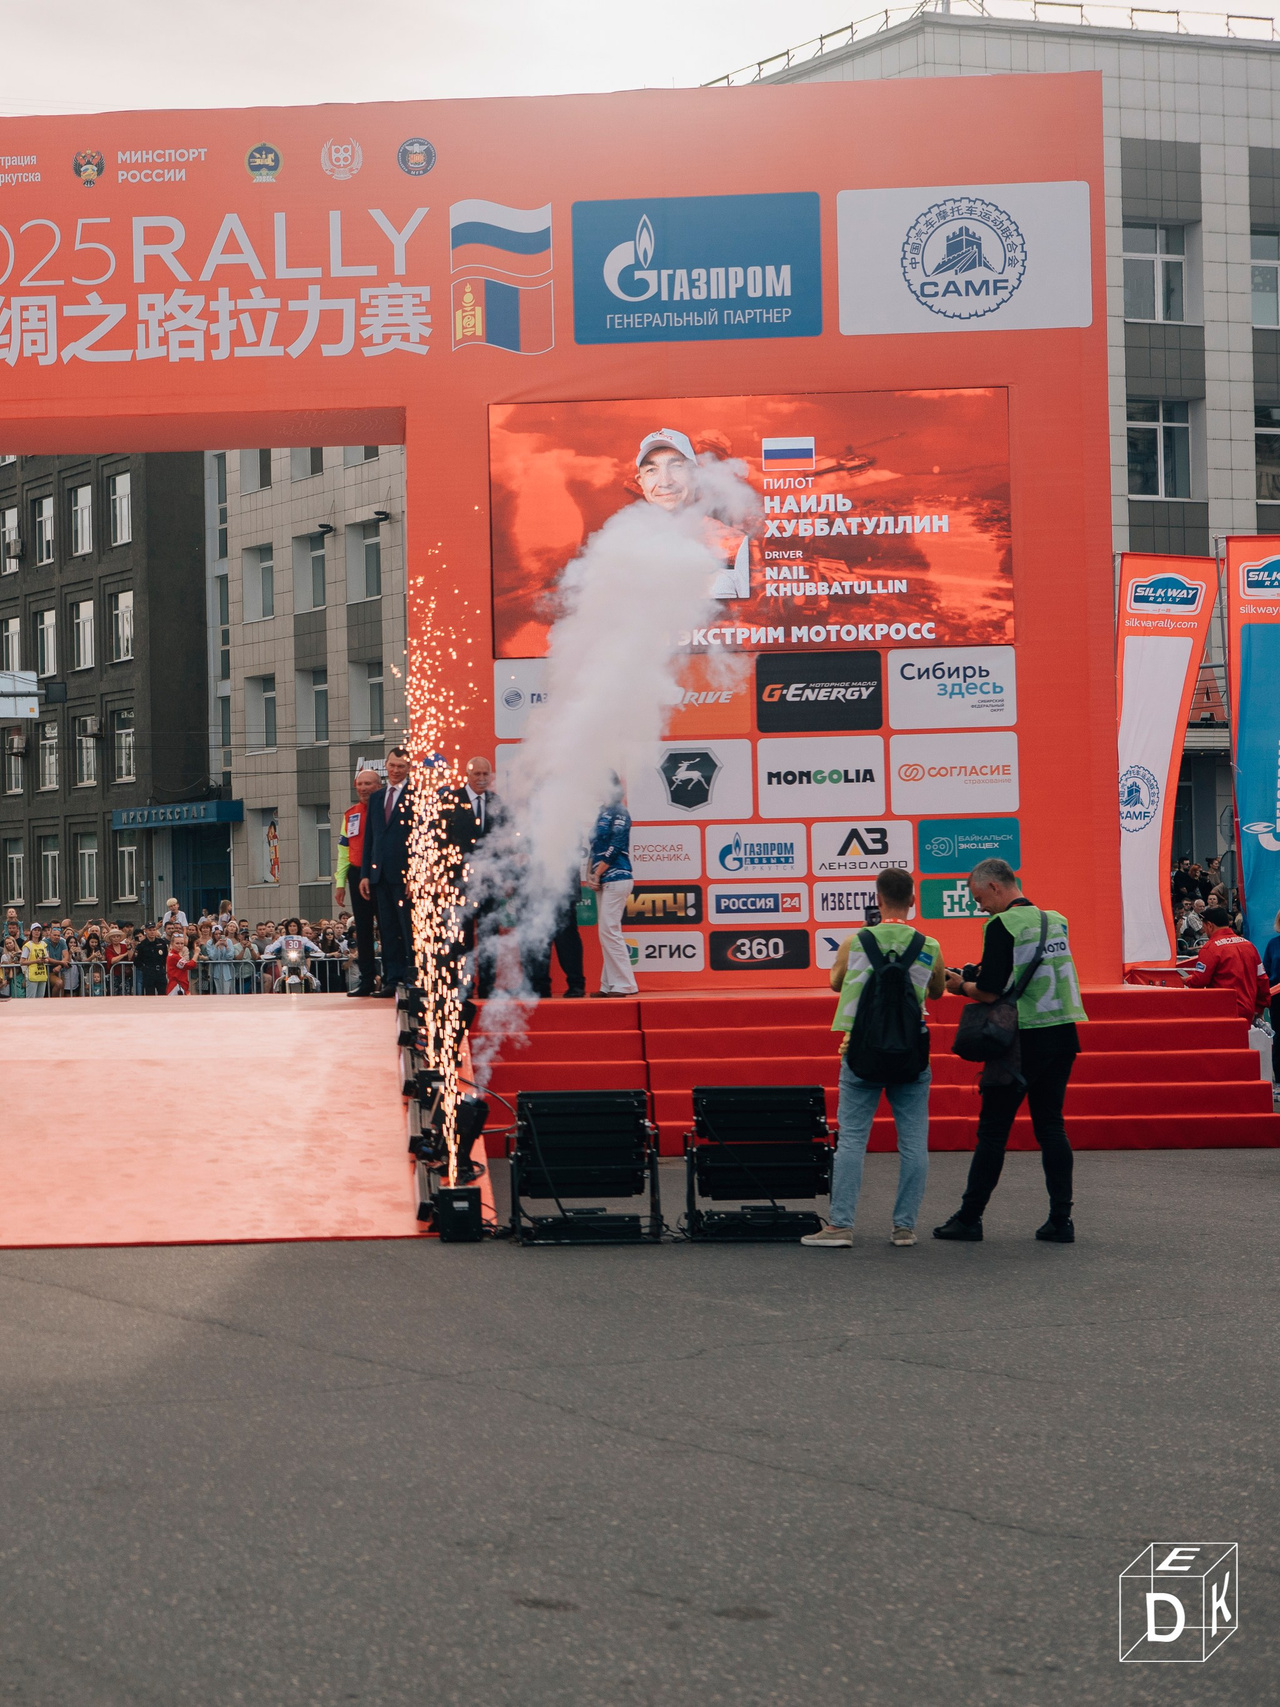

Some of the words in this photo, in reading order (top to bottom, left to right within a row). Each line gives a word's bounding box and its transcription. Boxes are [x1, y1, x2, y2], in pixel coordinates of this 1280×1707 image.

[117, 147, 208, 164] МИНСПОРТ
[117, 168, 186, 183] РОССИИ
[131, 207, 430, 283] RALLY
[660, 264, 792, 301] ГАЗПРОМ
[920, 279, 1009, 298] CAMF
[606, 308, 719, 329] ГЕНЕРАЛЬНЫЙ
[723, 308, 792, 325] ПАРТНЕР
[763, 477, 815, 490] ПИЛОТ
[764, 494, 852, 514] НАИЛЬ
[764, 514, 949, 538] ХУББАТУЛЛИН
[764, 550, 803, 560] DRIVER
[765, 566, 809, 580] NAIL
[765, 579, 908, 597] KHUBBATULLIN
[1135, 587, 1165, 597] SILK
[1167, 588, 1197, 598] WAY
[791, 622, 936, 643] МОТОКРОСС
[900, 662, 990, 683] Сибирь
[937, 681, 1004, 699] здесь
[767, 768, 875, 785] MONGOLIA
[927, 764, 1011, 778] СОГЛАСИЕ
[121, 804, 207, 824] ИРКУТСКСТАТ
[958, 833, 1014, 842] БАЙКАЛЬСК
[633, 844, 683, 853] РУССКАЯ
[743, 842, 794, 856] ГАЗПРОМ
[633, 853, 691, 862] МЕХАНИКА
[745, 856, 794, 865] ДОБЫЧА
[819, 861, 908, 871] ЛЕНЗОЛОТО
[721, 897, 775, 910] РОССИЯ
[782, 896, 800, 908] 24
[821, 891, 876, 911] ИЗВЕСТИ
[288, 940, 299, 949] 30
[645, 944, 696, 959] 2ГИС
[736, 938, 785, 960] 360
[1032, 961, 1081, 1013] 21
